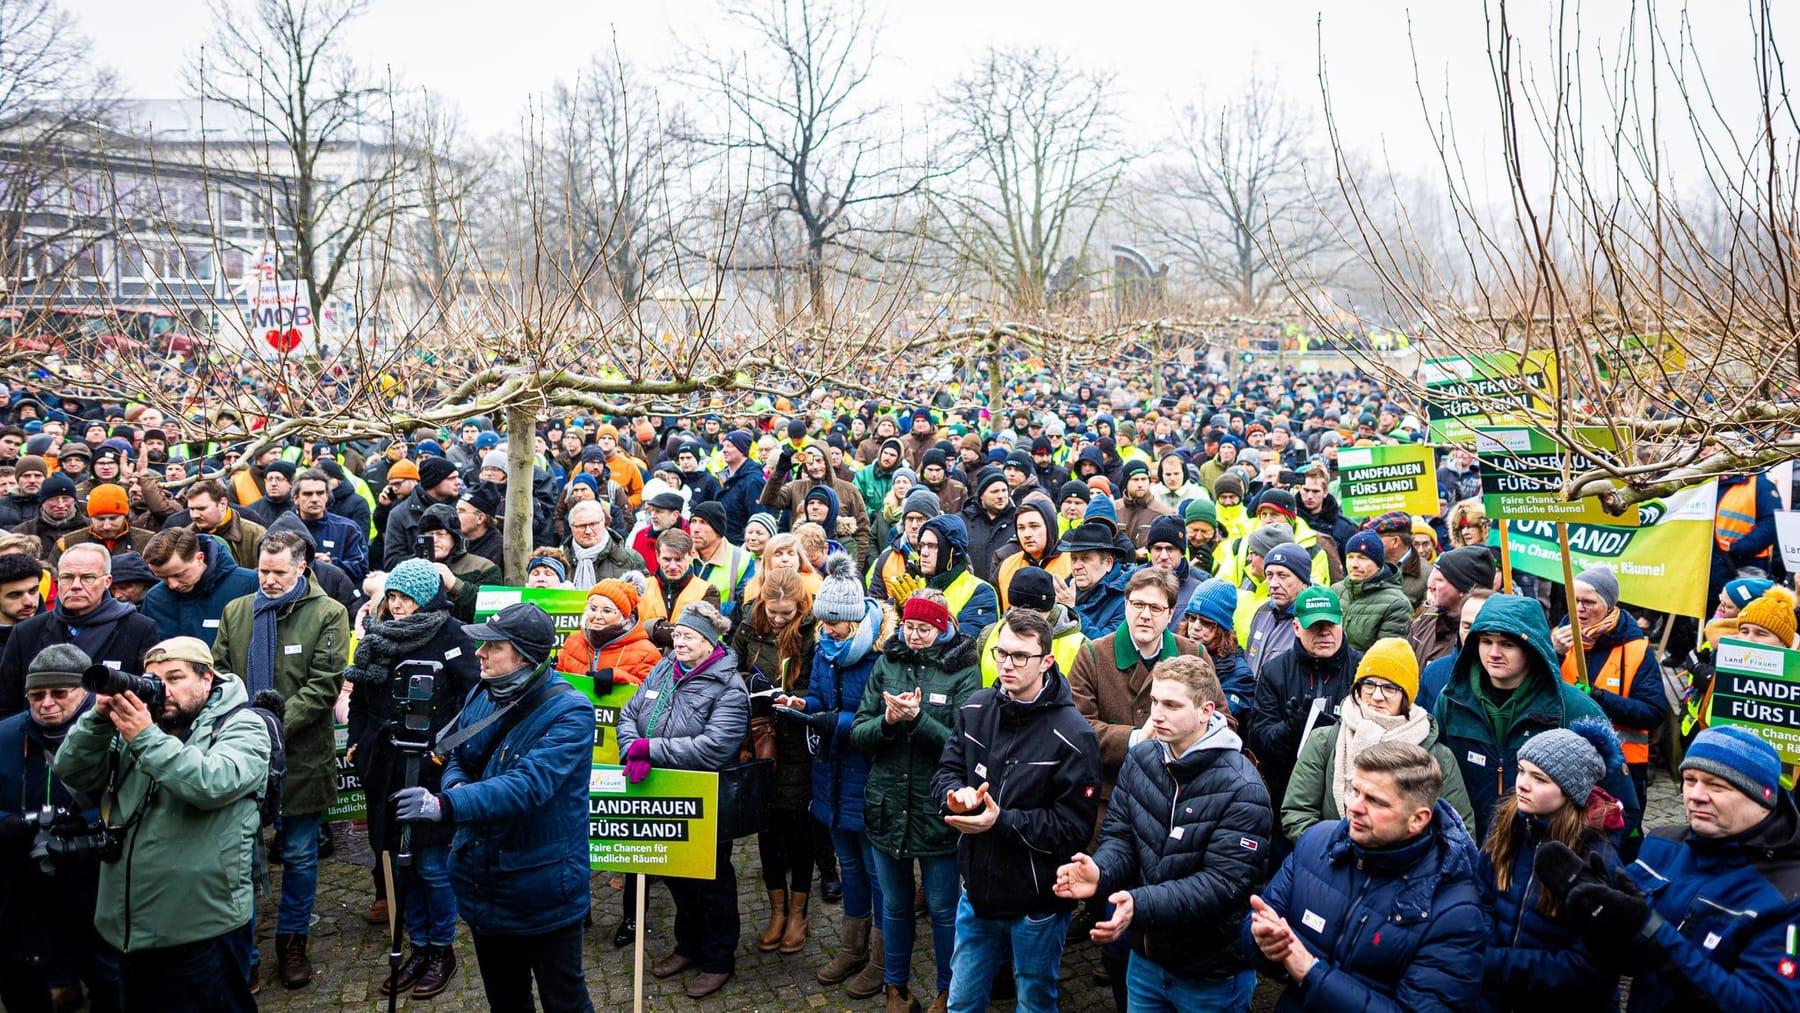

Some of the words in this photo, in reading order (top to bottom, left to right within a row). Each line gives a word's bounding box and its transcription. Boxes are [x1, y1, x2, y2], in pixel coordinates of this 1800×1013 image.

[251, 306, 311, 328] MOB
[1348, 463, 1421, 480] LANDFRAUEN
[1350, 481, 1377, 495] FÜRS
[1379, 479, 1414, 492] LAND!
[1498, 474, 1540, 491] FÜRS
[1501, 496, 1524, 505] Faire
[1502, 504, 1545, 514] ländliche
[1548, 504, 1585, 514] Räume!
[1508, 540, 1526, 554] aire
[1528, 543, 1562, 561] Chanc
[1621, 561, 1665, 576] Räume!
[1724, 656, 1743, 664] Land
[1749, 659, 1777, 668] Frauen
[1732, 699, 1784, 722] FÜRS
[589, 799, 696, 815] LANDFRAUEN
[589, 819, 629, 837] FÜRS
[633, 822, 682, 838] LAND!
[589, 843, 611, 853] Faire
[613, 843, 652, 853] Chancen
[654, 843, 668, 853] für
[589, 853, 631, 864] ländliche
[633, 854, 668, 864] Räume!
